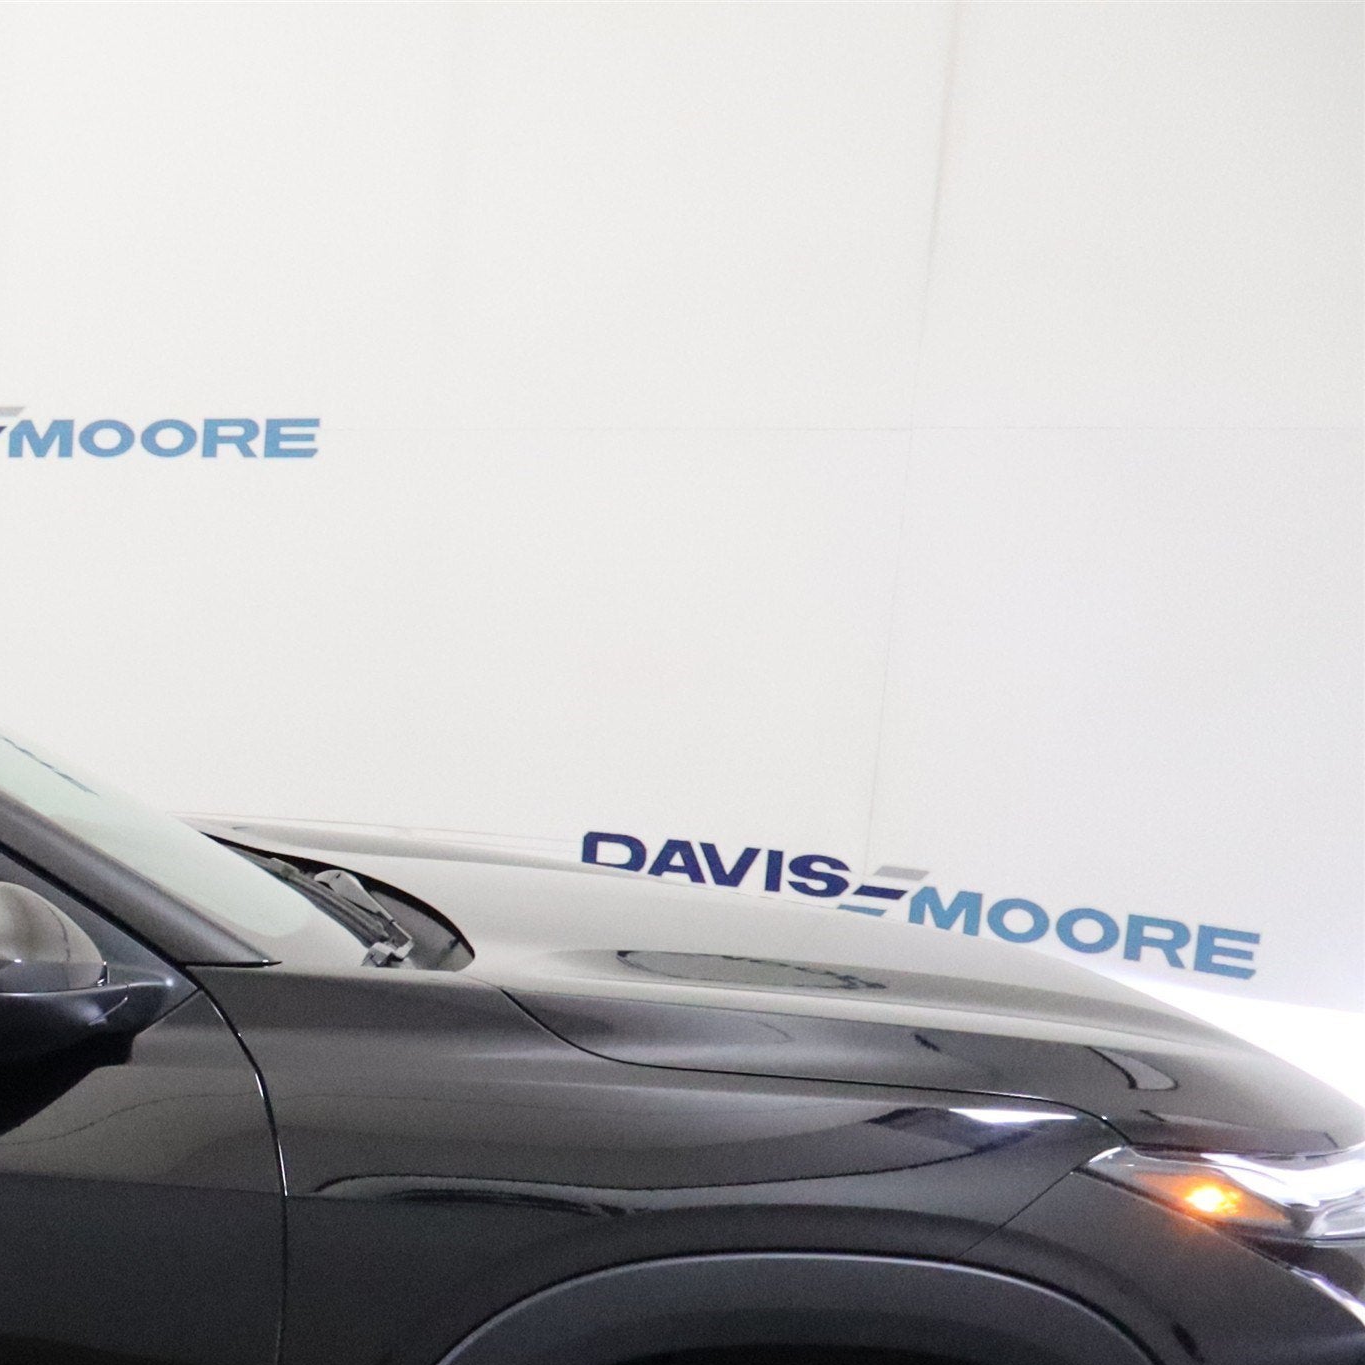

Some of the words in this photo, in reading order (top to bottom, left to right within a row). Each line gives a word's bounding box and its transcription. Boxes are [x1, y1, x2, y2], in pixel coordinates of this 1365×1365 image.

[8, 417, 321, 459] MOORE
[581, 831, 851, 898] DAVIS
[907, 885, 1261, 980] MOORE
